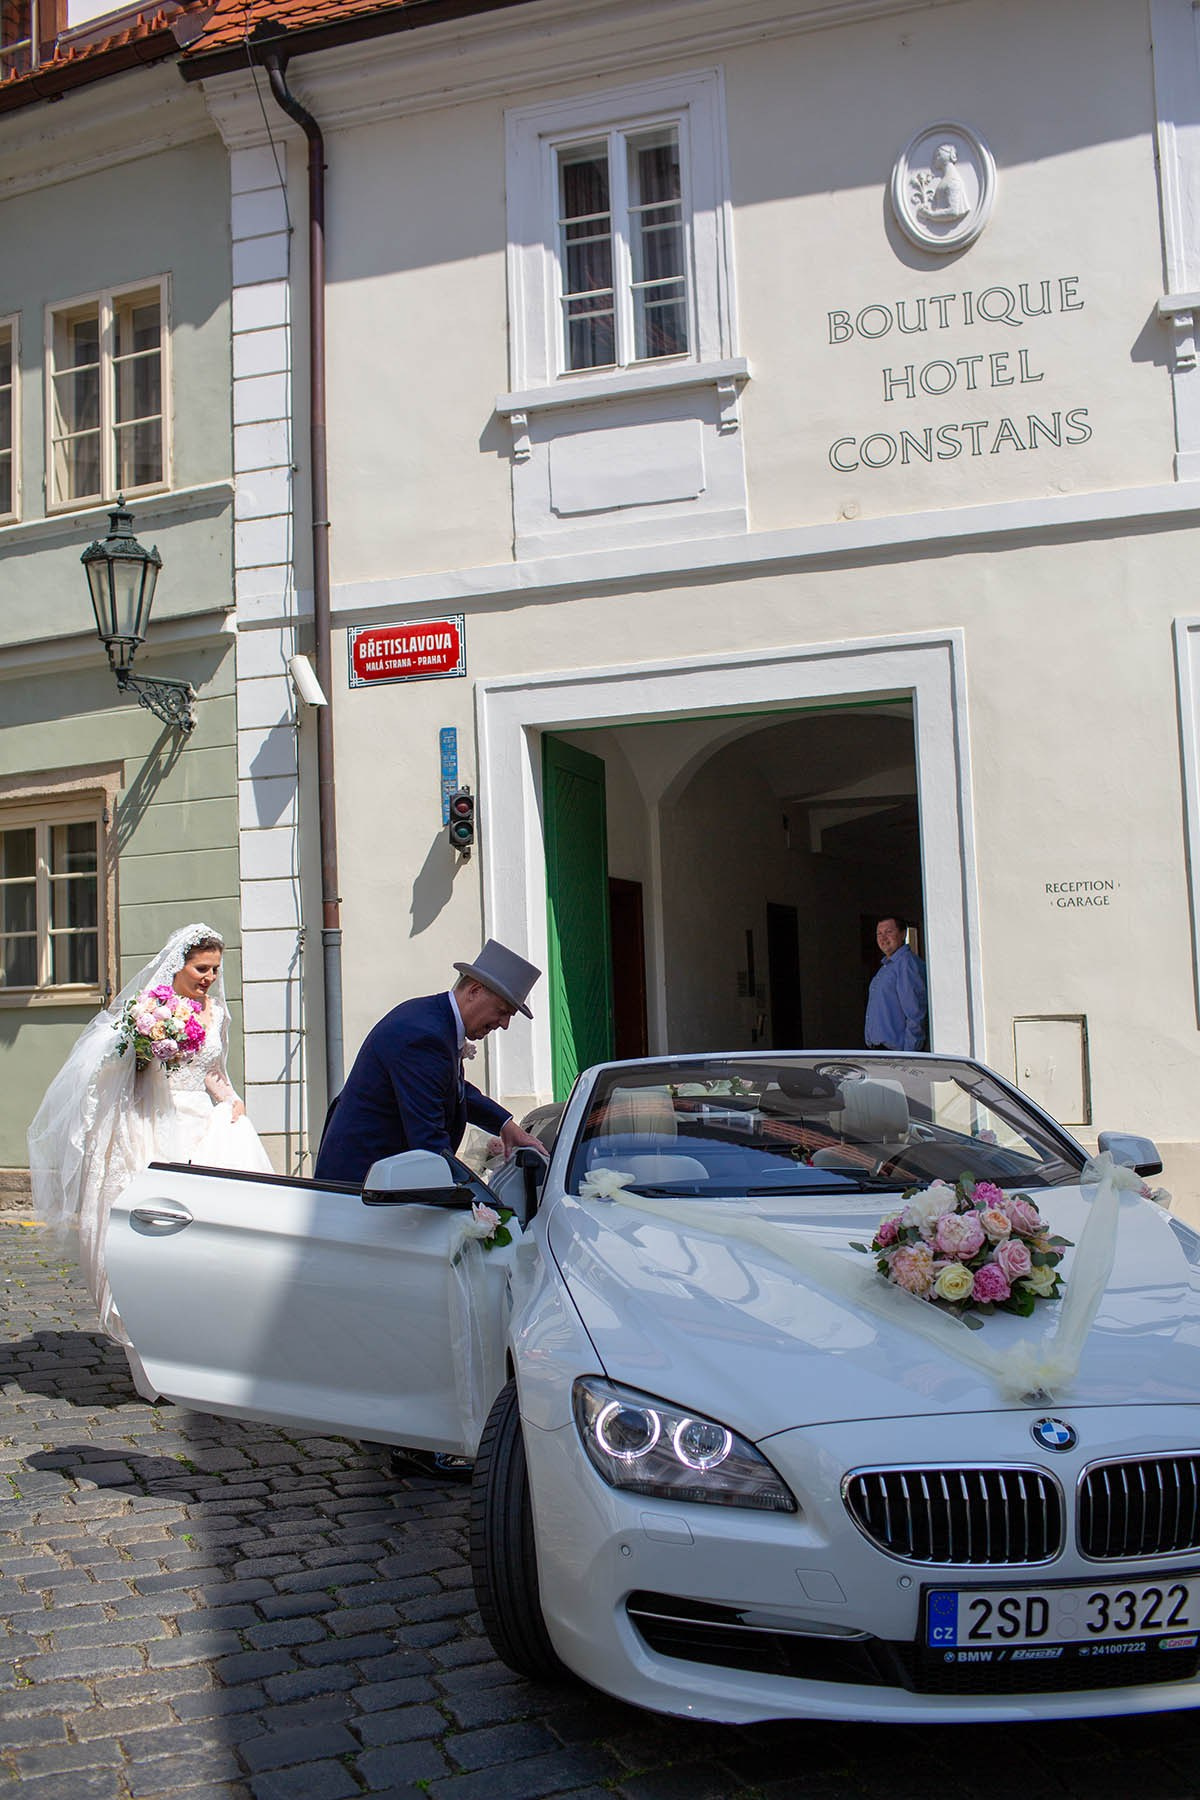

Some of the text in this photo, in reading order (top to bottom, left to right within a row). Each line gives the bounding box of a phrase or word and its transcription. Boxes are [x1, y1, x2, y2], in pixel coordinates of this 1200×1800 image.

[828, 276, 1085, 344] BOUTIQUE
[882, 349, 1044, 401] HOTEL
[828, 408, 1093, 472] CONSTANS
[359, 633, 452, 659] BŘETISLAVOVA
[365, 659, 384, 672] MALÁ
[385, 658, 411, 670] STRANA
[418, 655, 441, 666] PRAHA
[443, 654, 447, 664] 1
[1045, 879, 1114, 893] RECEPTION
[1056, 895, 1110, 908] GARAGE
[968, 1583, 1190, 1640] 2SD 3322
[933, 1627, 953, 1640] CZ
[957, 1650, 993, 1662] BMW
[1092, 1642, 1147, 1655] 241007222
